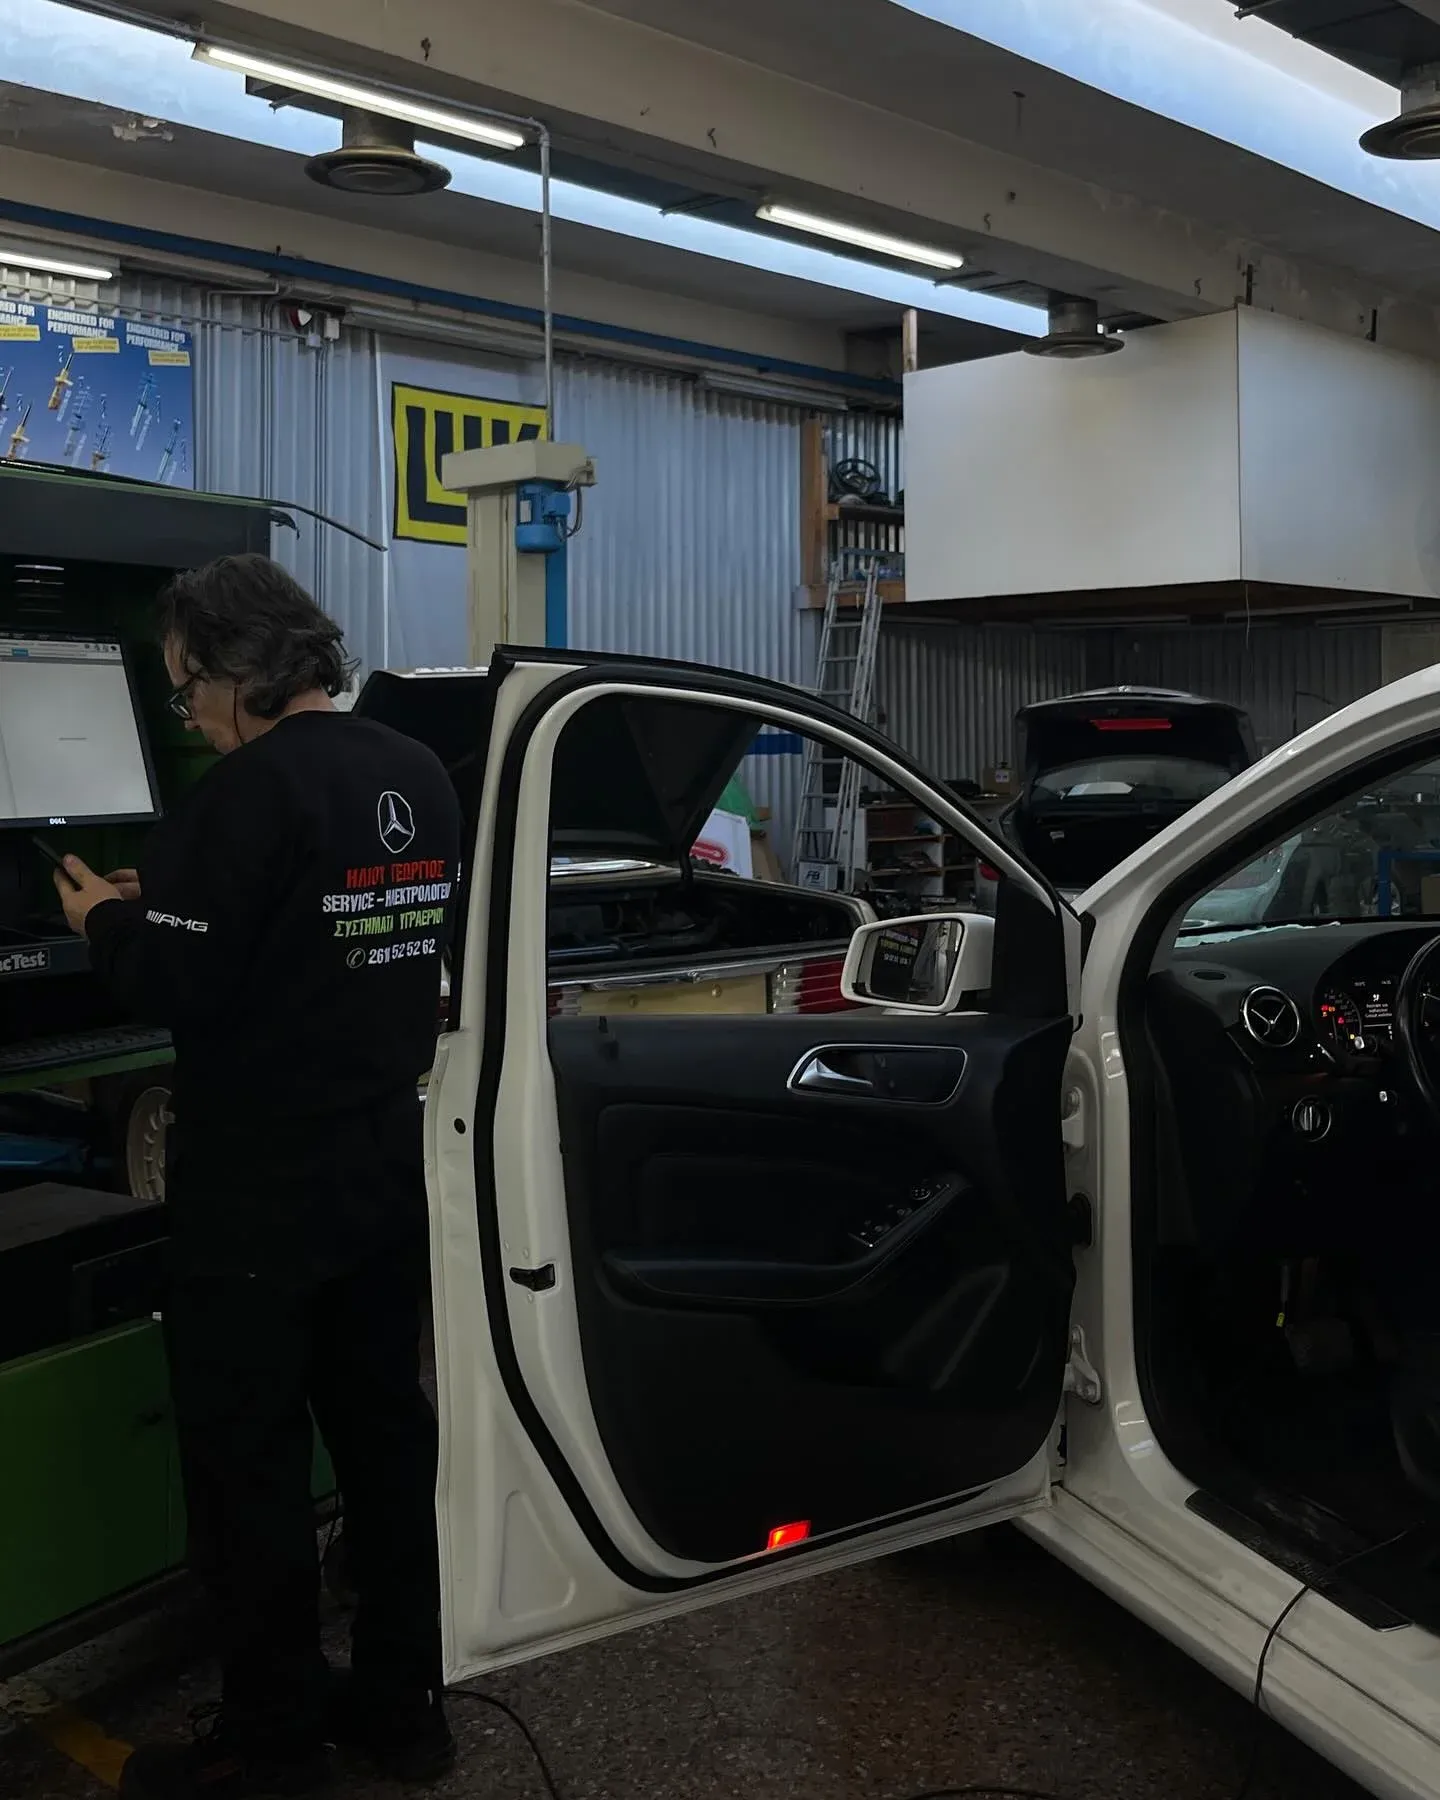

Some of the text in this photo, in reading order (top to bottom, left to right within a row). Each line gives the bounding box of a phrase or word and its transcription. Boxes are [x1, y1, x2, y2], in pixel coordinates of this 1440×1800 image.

[18, 304, 35, 317] FOR
[48, 309, 115, 330] ENGINEERED FOR
[47, 321, 107, 338] PERFORMANCE
[126, 322, 186, 343] ENGINEERED FOR
[49, 817, 66, 825] DELL
[346, 860, 445, 888] ΗΛΙΟΥ ΓΕΩΡΓΙΟΣ
[323, 892, 376, 912] SERVICE
[0, 951, 46, 973] cTest
